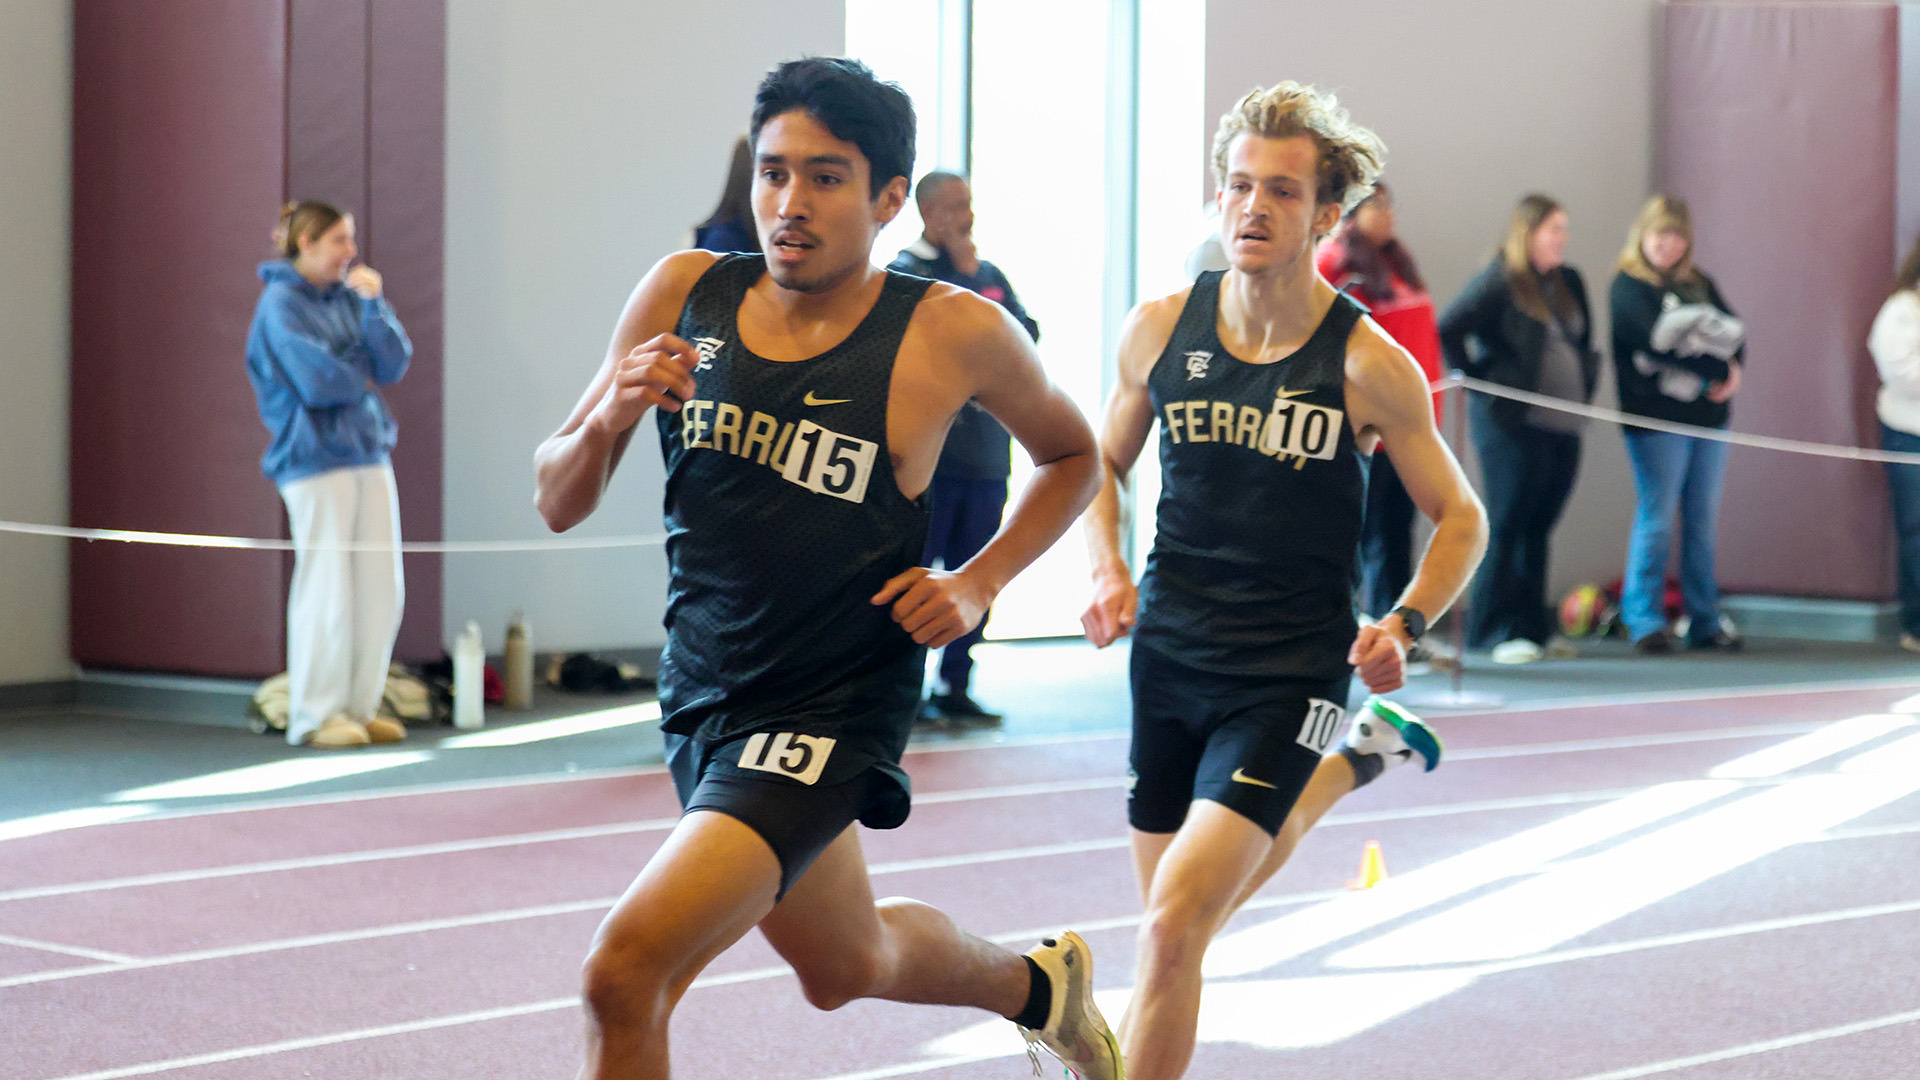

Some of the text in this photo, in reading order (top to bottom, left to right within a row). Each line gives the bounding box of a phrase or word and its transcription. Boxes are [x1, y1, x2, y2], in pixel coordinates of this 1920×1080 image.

[1279, 404, 1329, 455] 10
[798, 428, 862, 494] 15
[1306, 702, 1339, 751] 10
[755, 732, 813, 774] 15
